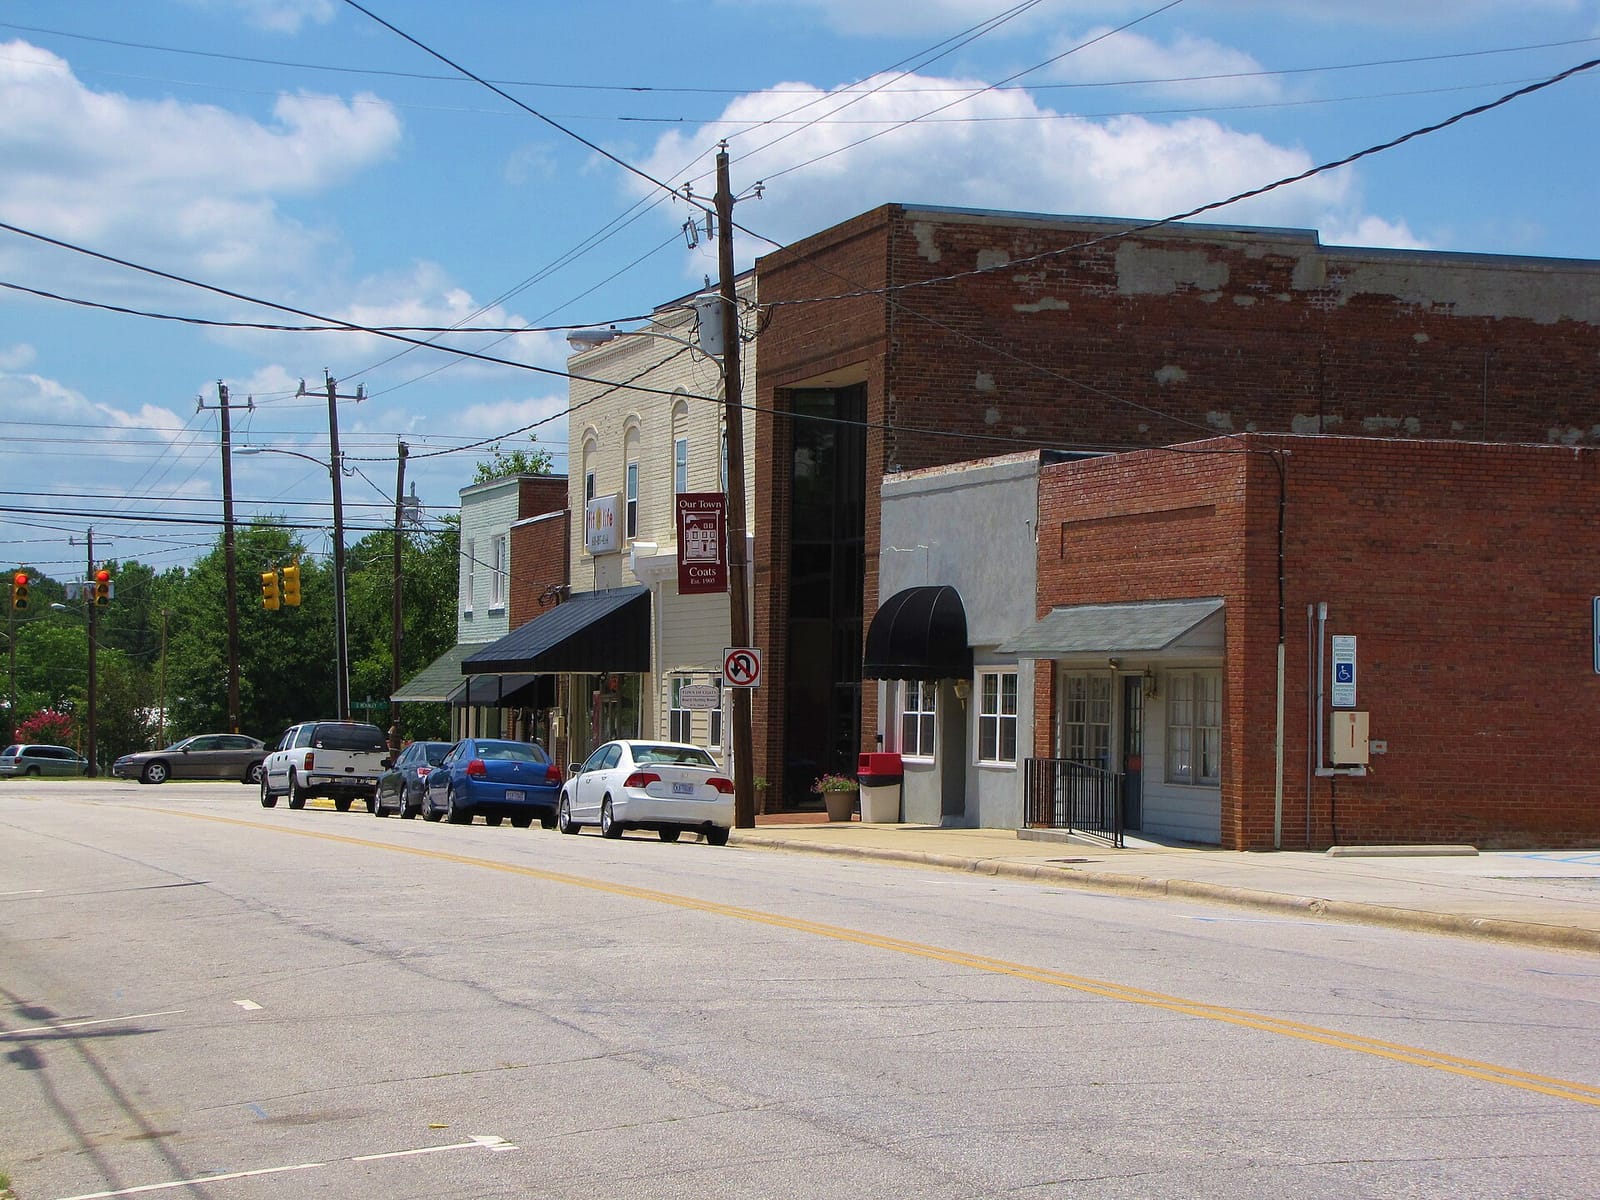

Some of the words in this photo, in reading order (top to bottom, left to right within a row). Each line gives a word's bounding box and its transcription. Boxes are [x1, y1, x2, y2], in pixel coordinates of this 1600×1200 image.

[679, 499, 696, 509] Our
[698, 499, 722, 509] Town
[689, 567, 717, 577] Coats
